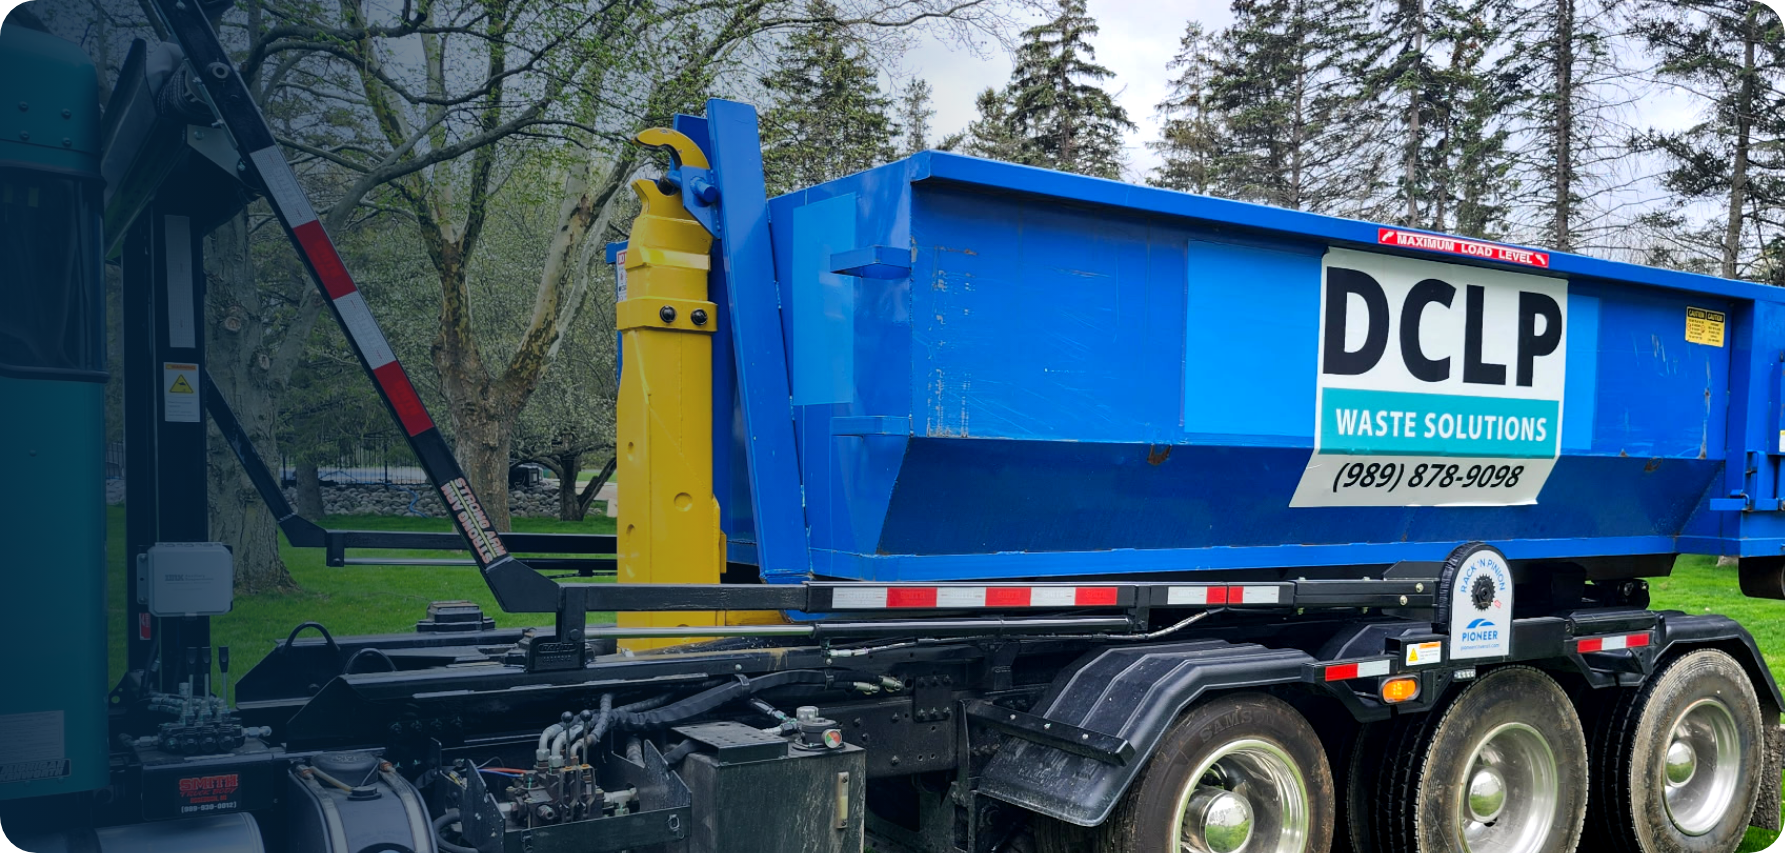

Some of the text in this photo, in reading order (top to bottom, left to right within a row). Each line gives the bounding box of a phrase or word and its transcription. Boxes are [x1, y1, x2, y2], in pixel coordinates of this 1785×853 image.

[1397, 234, 1533, 264] MAXIMUM LOAD LEVEL
[1322, 266, 1563, 388] DCLP
[1336, 408, 1548, 442] WASTE SOLUTIONS
[1332, 461, 1524, 493] (989) 878-9098
[454, 477, 507, 557] STRONG ARM
[1460, 562, 1477, 593] RACK
[1487, 559, 1506, 591] PINION
[1462, 630, 1498, 641] PIONEER
[179, 774, 238, 790] SMITH
